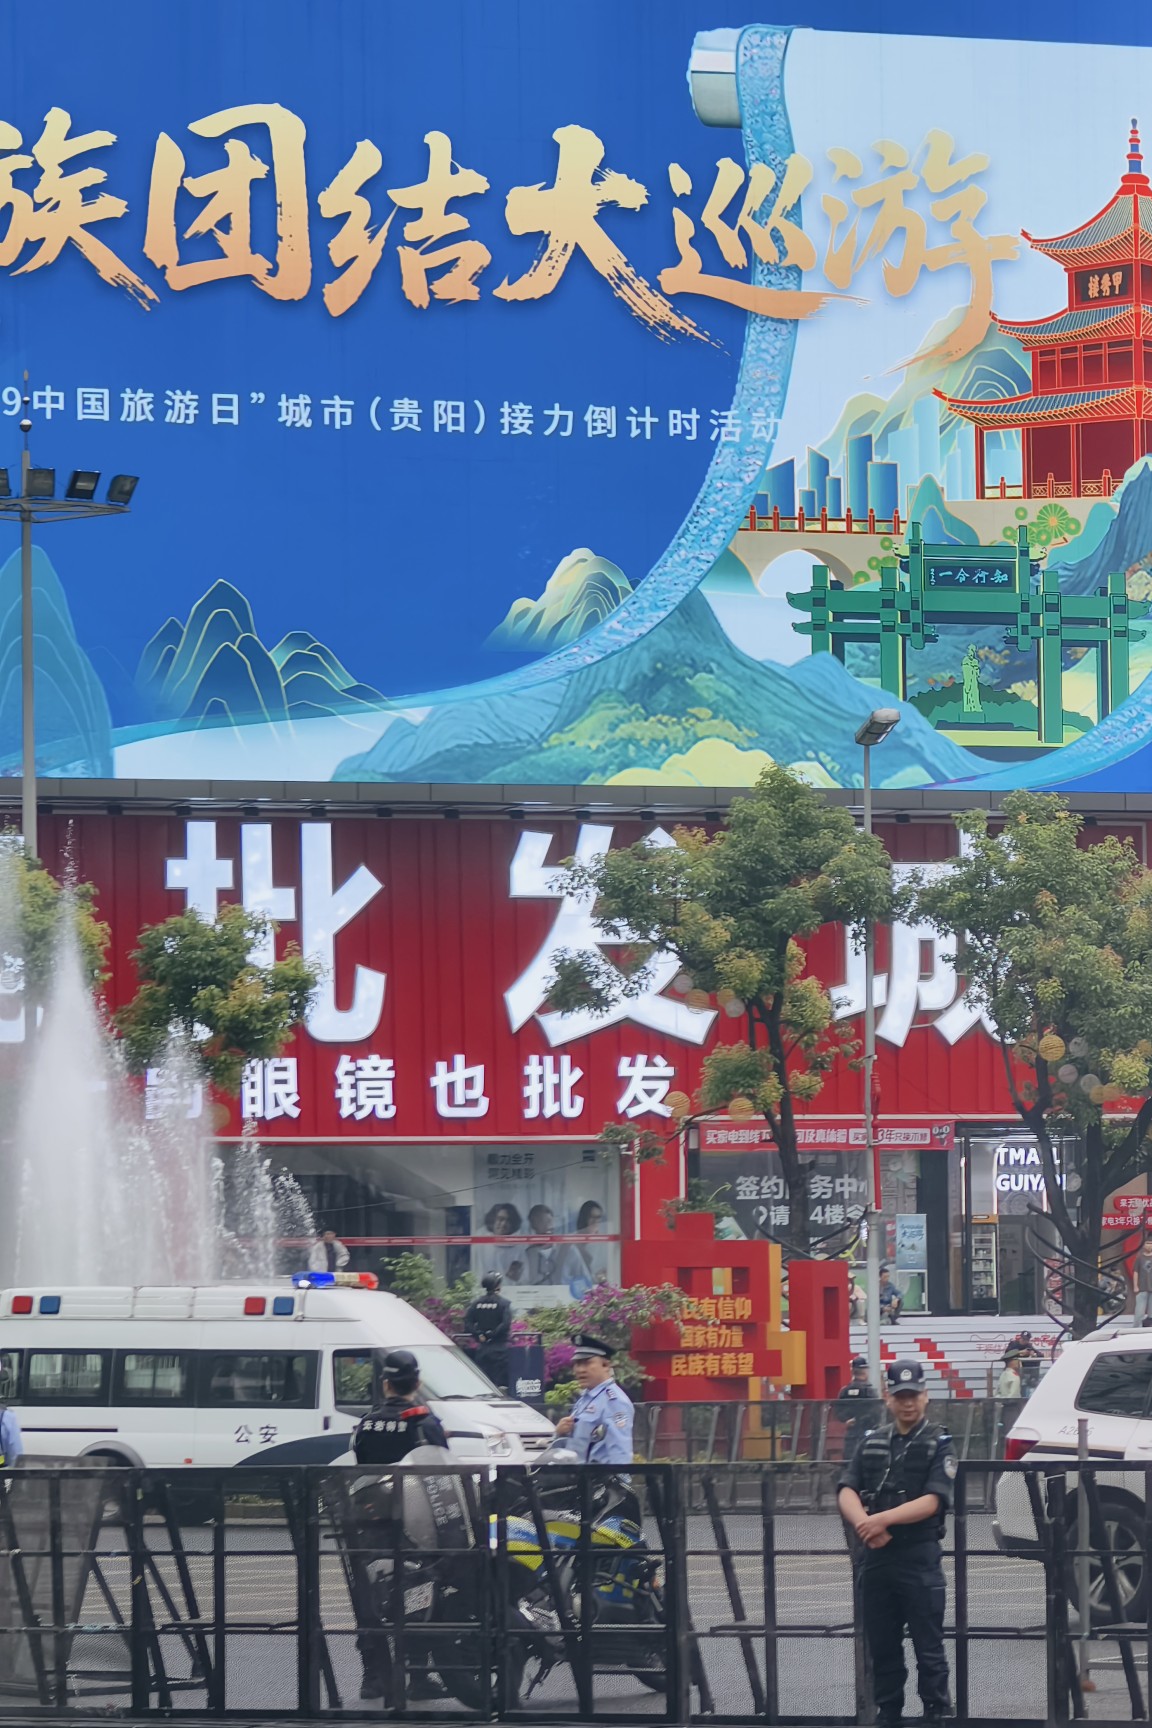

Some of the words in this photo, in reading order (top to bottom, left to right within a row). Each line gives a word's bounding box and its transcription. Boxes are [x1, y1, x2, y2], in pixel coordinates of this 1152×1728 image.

[90, 1053, 677, 1120] 眼镜也批发
[996, 1147, 1061, 1166] TMAL
[735, 1175, 868, 1200] 签约务中
[769, 1204, 866, 1226] 请4楼
[671, 1352, 755, 1377] 民族有希望
[234, 1424, 279, 1444] 公安
